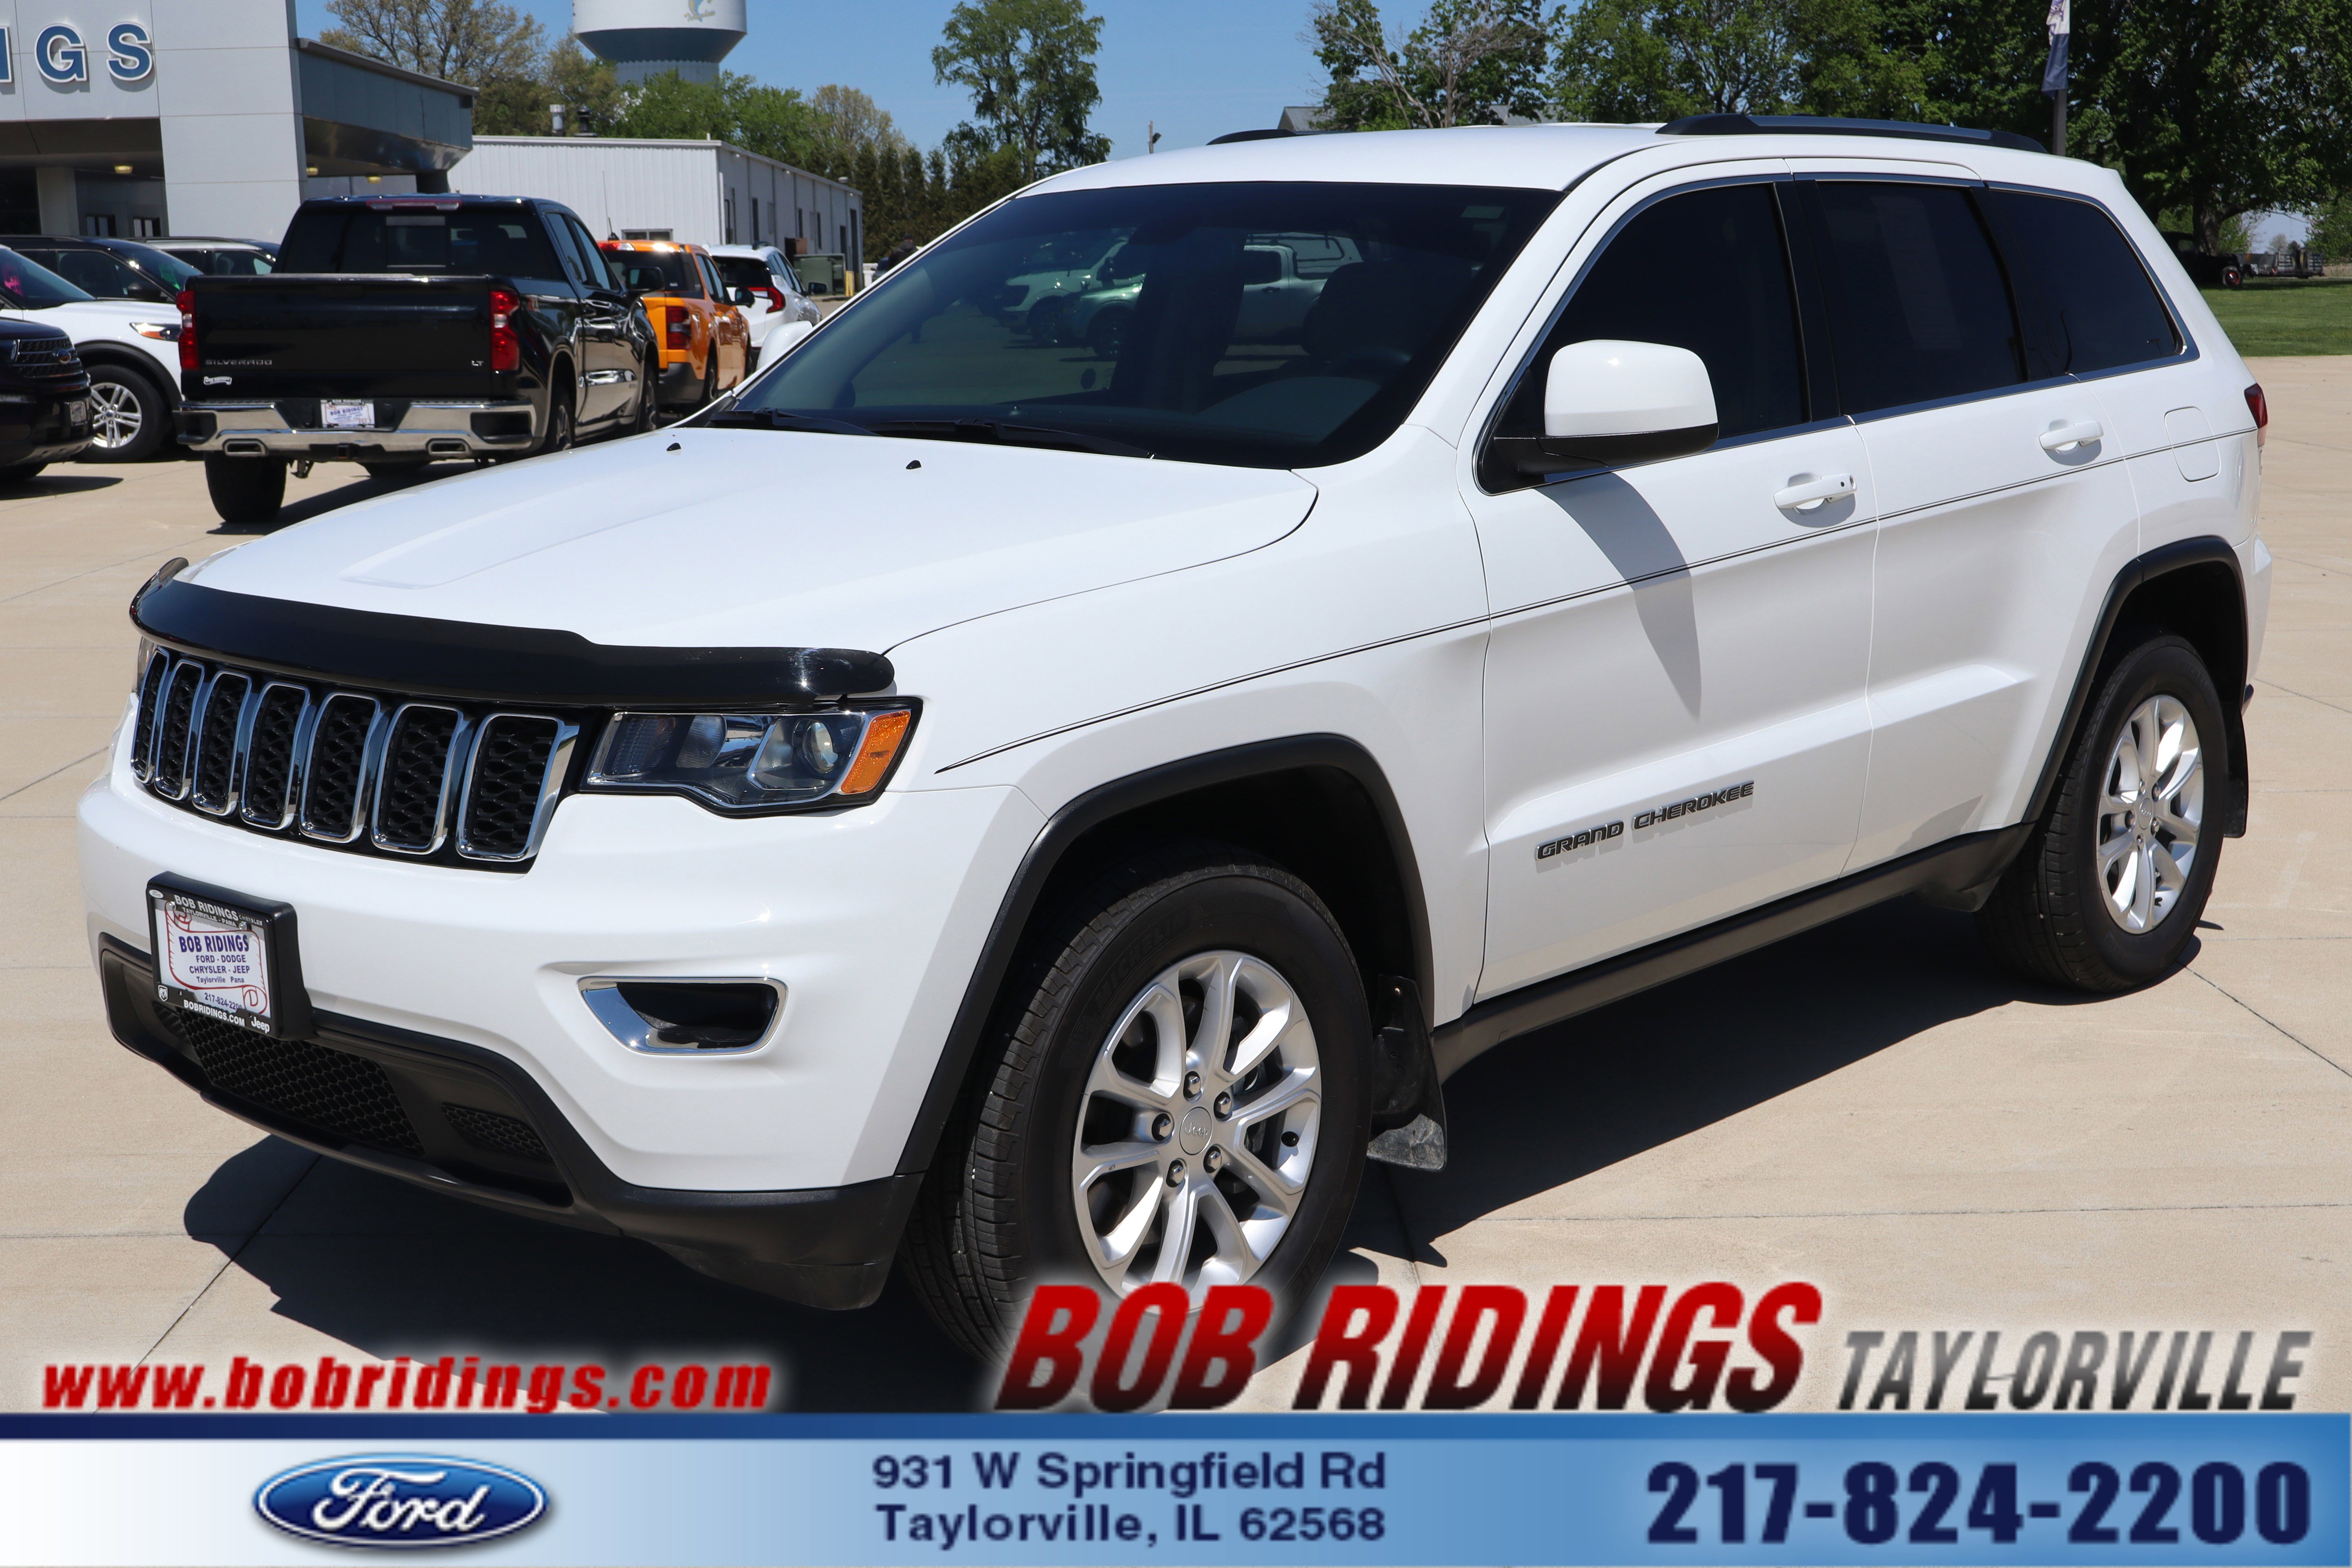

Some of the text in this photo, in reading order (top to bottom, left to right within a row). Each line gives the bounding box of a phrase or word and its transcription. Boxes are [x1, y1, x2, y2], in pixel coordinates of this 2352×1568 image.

[1535, 780, 1754, 860] GRAND CHEROKEE
[174, 894, 239, 921] BOB RIDINGS
[182, 906, 217, 922] TAYLORVILLE
[222, 918, 237, 927] PANA
[239, 915, 263, 926] CHRYSLER
[179, 934, 249, 952] BOB RIDINGS
[221, 955, 246, 963] DODGE
[1095, 910, 1191, 1012] MICHELIN
[189, 966, 227, 974] CHRYSLER
[196, 976, 226, 984] Taylorville
[184, 999, 245, 1027] BOBRIDINGS.COM
[251, 1016, 270, 1033] Jeep
[1184, 1122, 1208, 1139] Jeep
